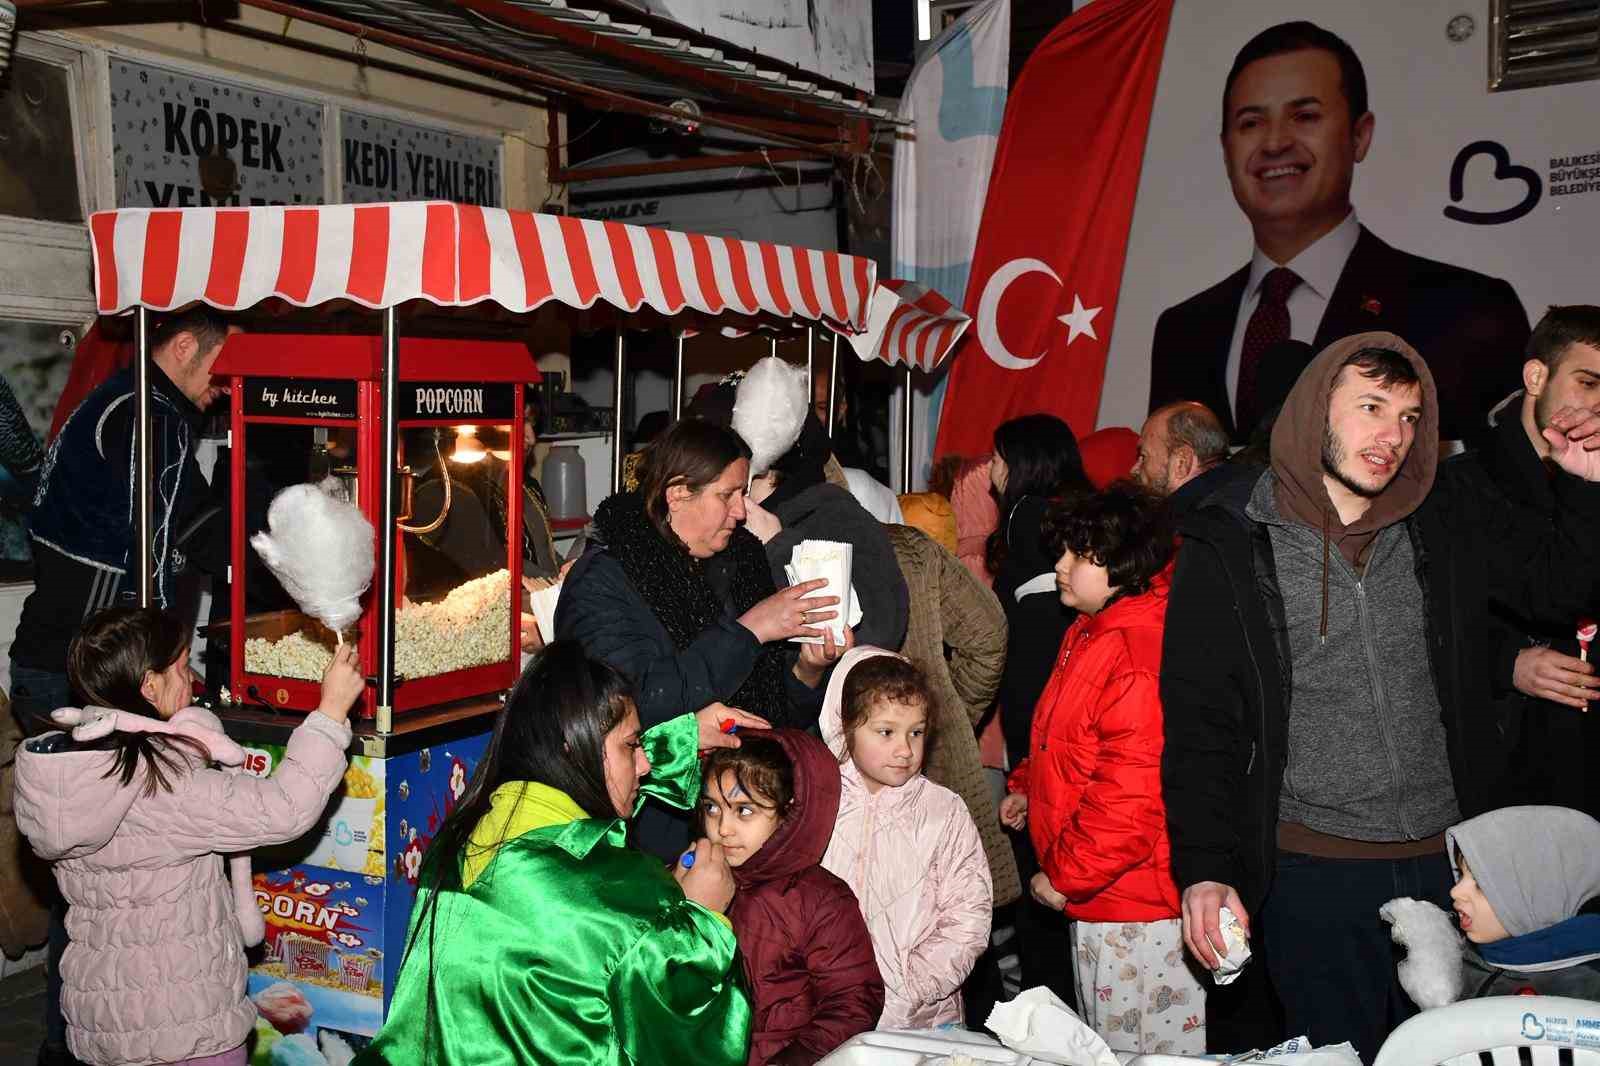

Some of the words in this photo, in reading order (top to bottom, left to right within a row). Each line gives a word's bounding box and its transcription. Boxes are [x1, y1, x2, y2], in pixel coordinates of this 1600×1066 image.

[163, 97, 284, 173] KÖPEK
[345, 139, 398, 191] KEDİ
[406, 151, 495, 207] YEMLERİ
[262, 387, 278, 408] by
[283, 388, 338, 405] kitchen
[415, 387, 484, 414] POPCORN
[255, 890, 339, 930] CORN
